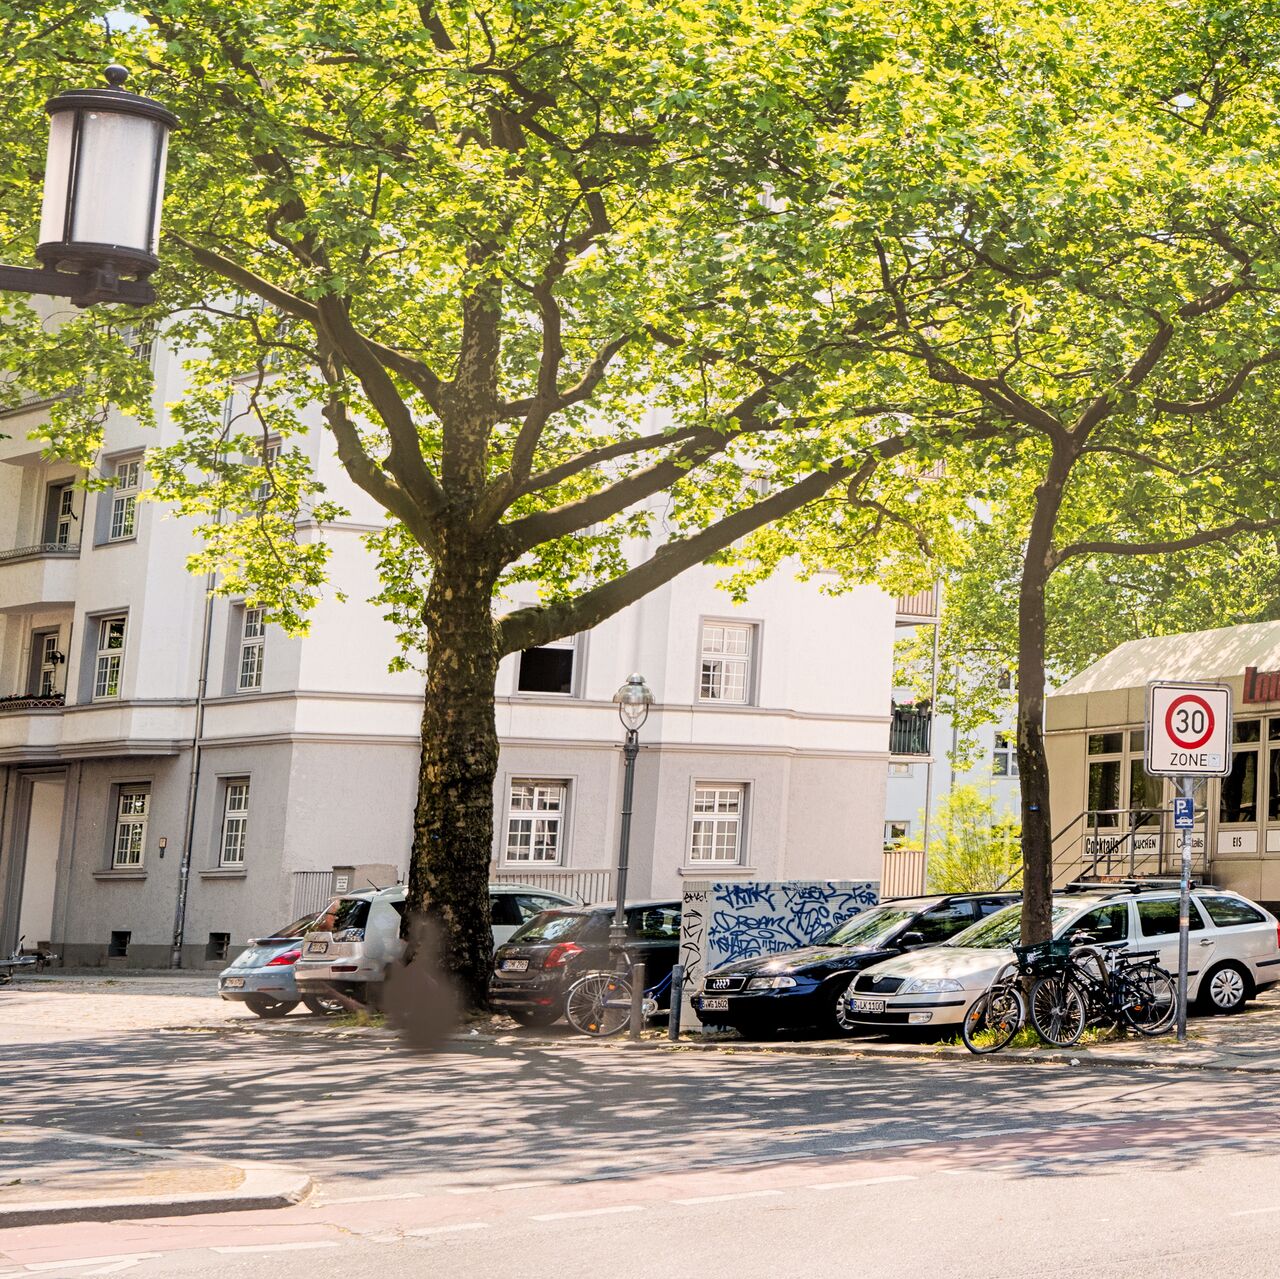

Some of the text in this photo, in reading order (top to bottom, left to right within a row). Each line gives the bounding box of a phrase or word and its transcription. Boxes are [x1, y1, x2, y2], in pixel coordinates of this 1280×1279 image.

[1176, 709, 1205, 734] 30
[1170, 753, 1208, 767] ZONE
[1176, 838, 1204, 848] Ctails
[1232, 837, 1242, 848] EIS
